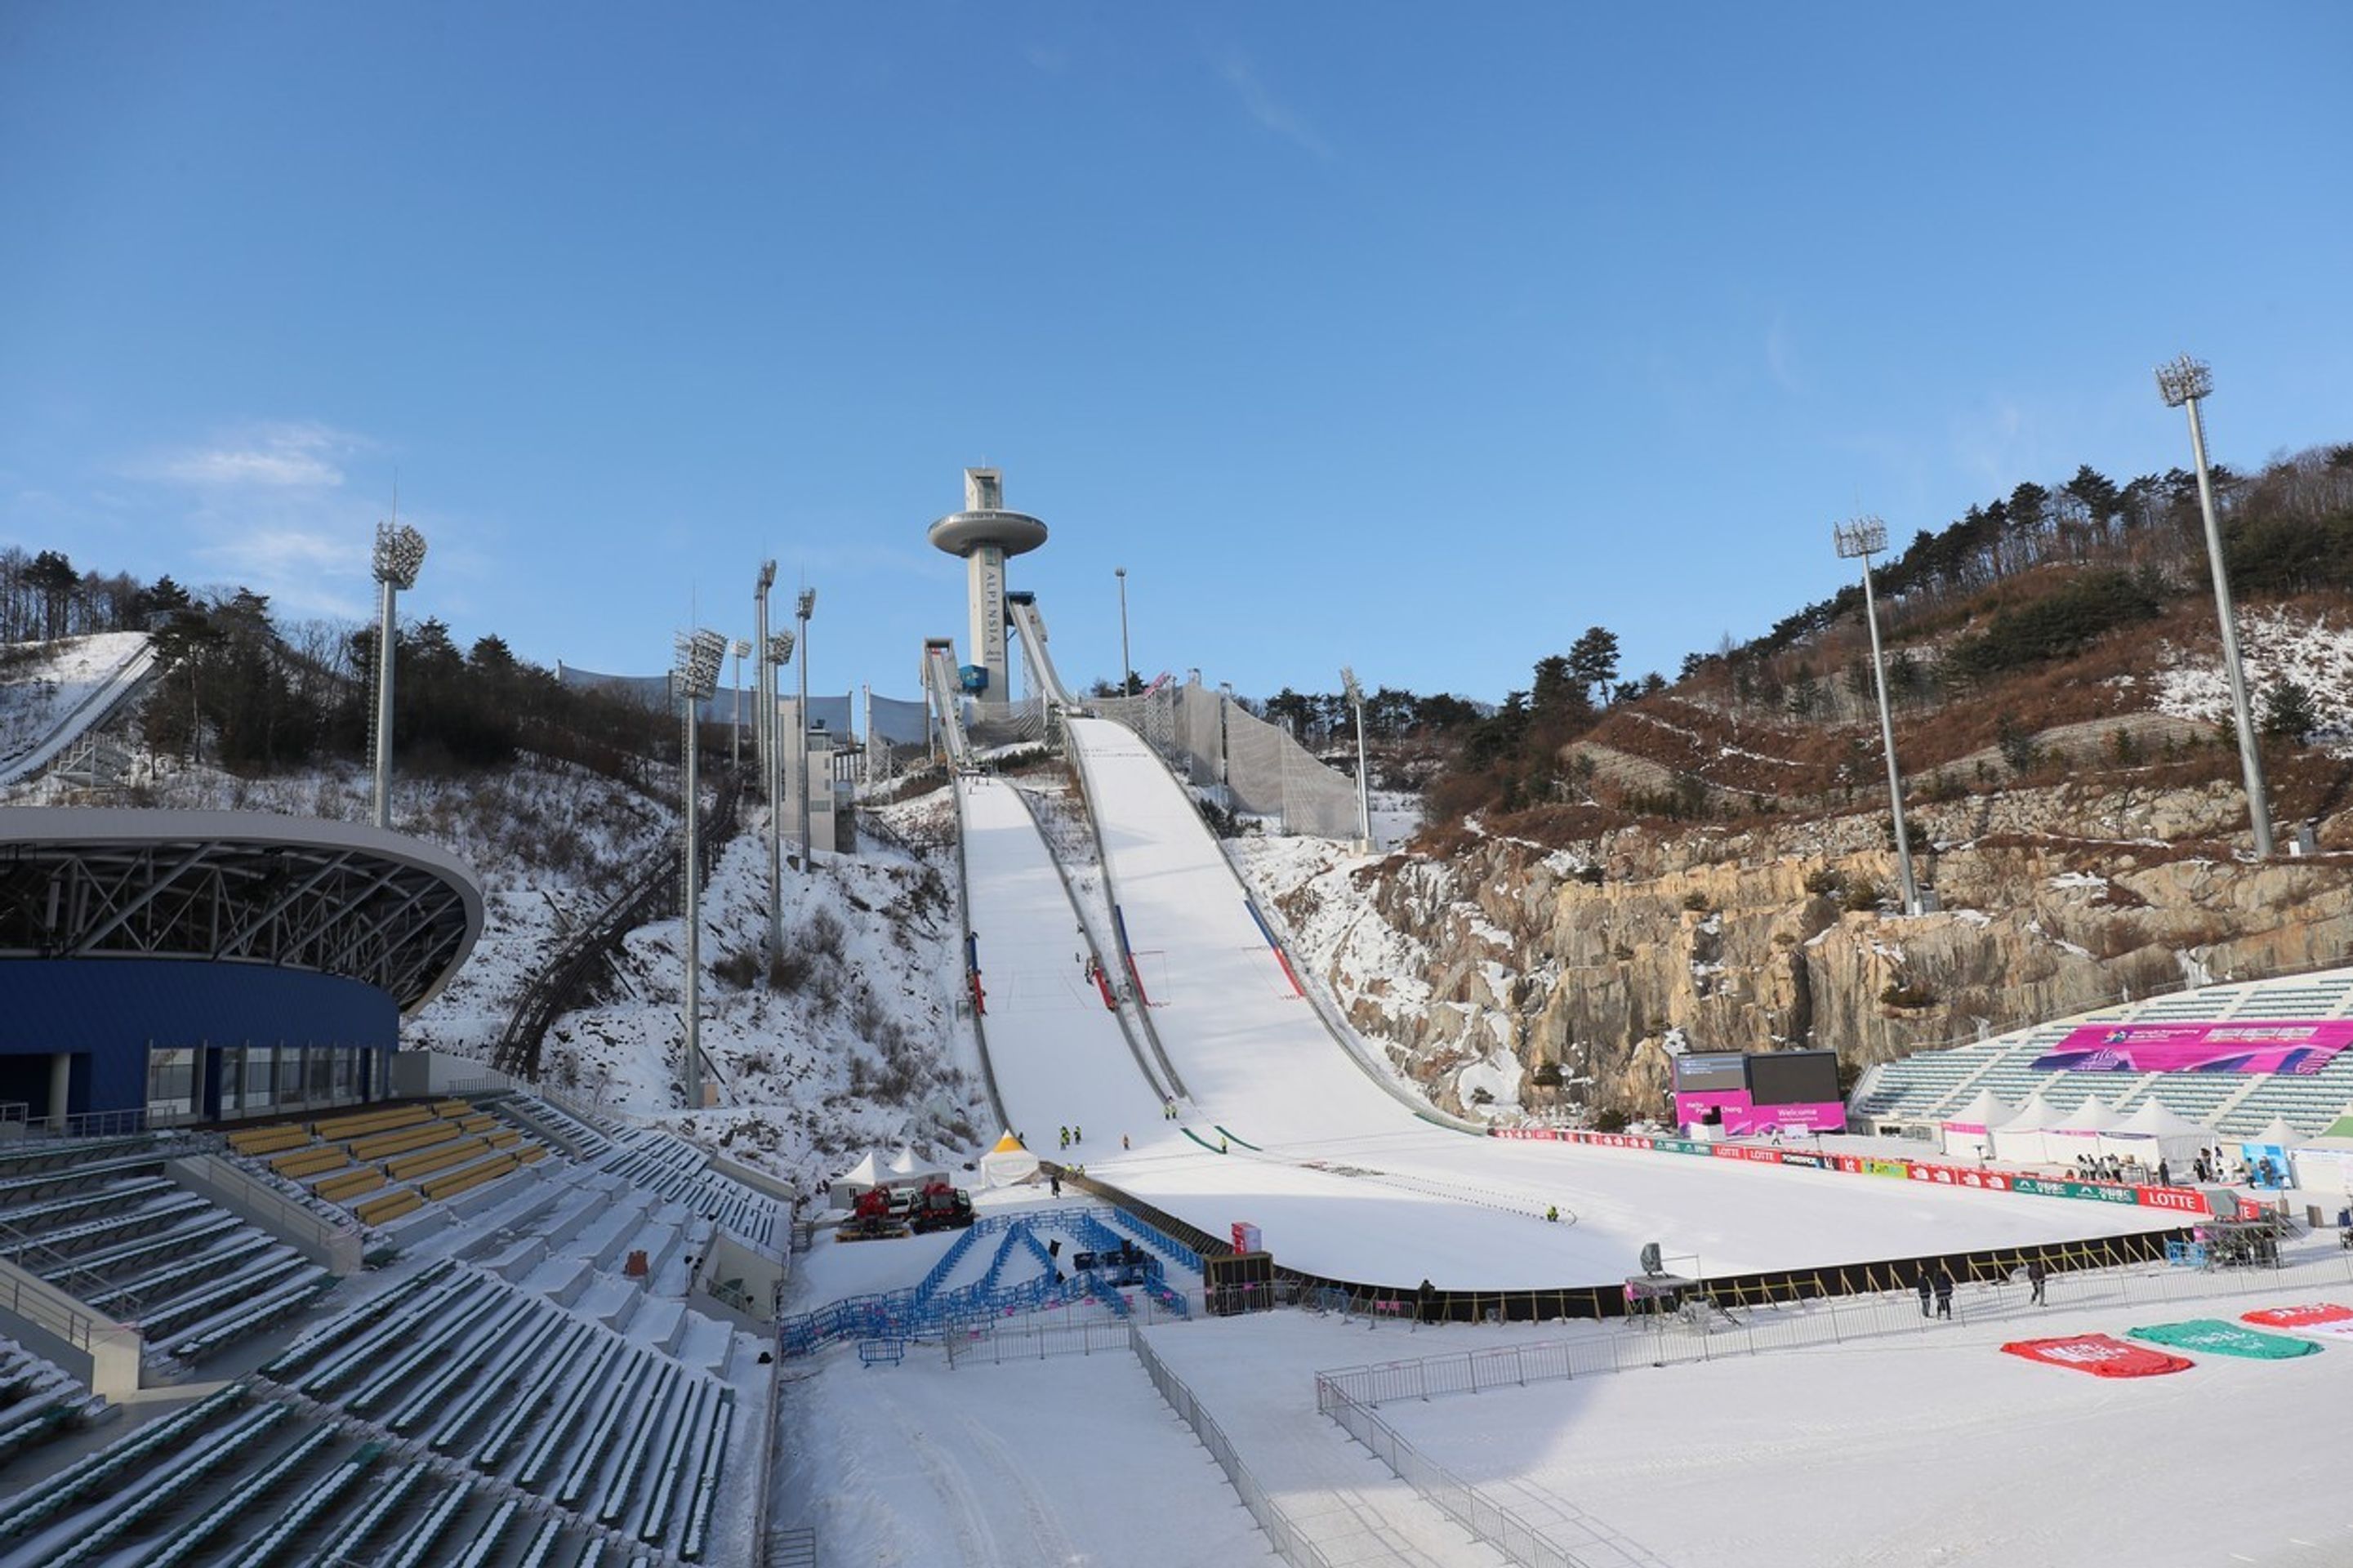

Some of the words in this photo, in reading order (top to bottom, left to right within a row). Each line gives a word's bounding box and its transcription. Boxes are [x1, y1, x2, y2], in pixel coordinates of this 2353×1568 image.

[986, 572, 999, 644] ALPENSIA
[1717, 1145, 1740, 1158] LOTTE
[1750, 1148, 1775, 1161] LOTTE
[2148, 1192, 2196, 1209] LOTTE
